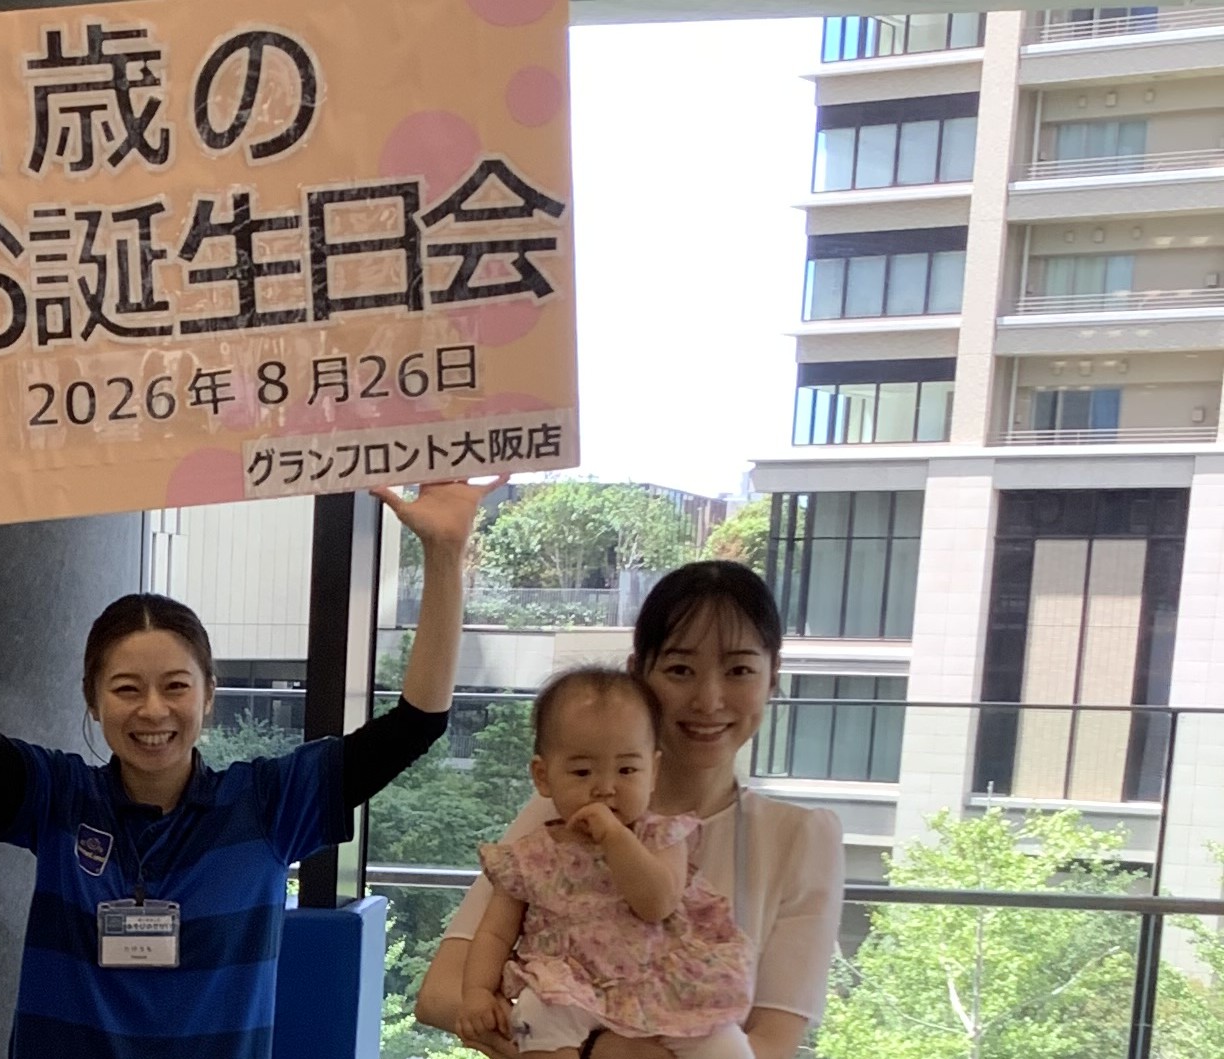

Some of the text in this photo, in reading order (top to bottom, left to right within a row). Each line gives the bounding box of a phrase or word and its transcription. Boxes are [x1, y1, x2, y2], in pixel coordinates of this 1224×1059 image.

[247, 423, 563, 487] グランフロント大阪店
